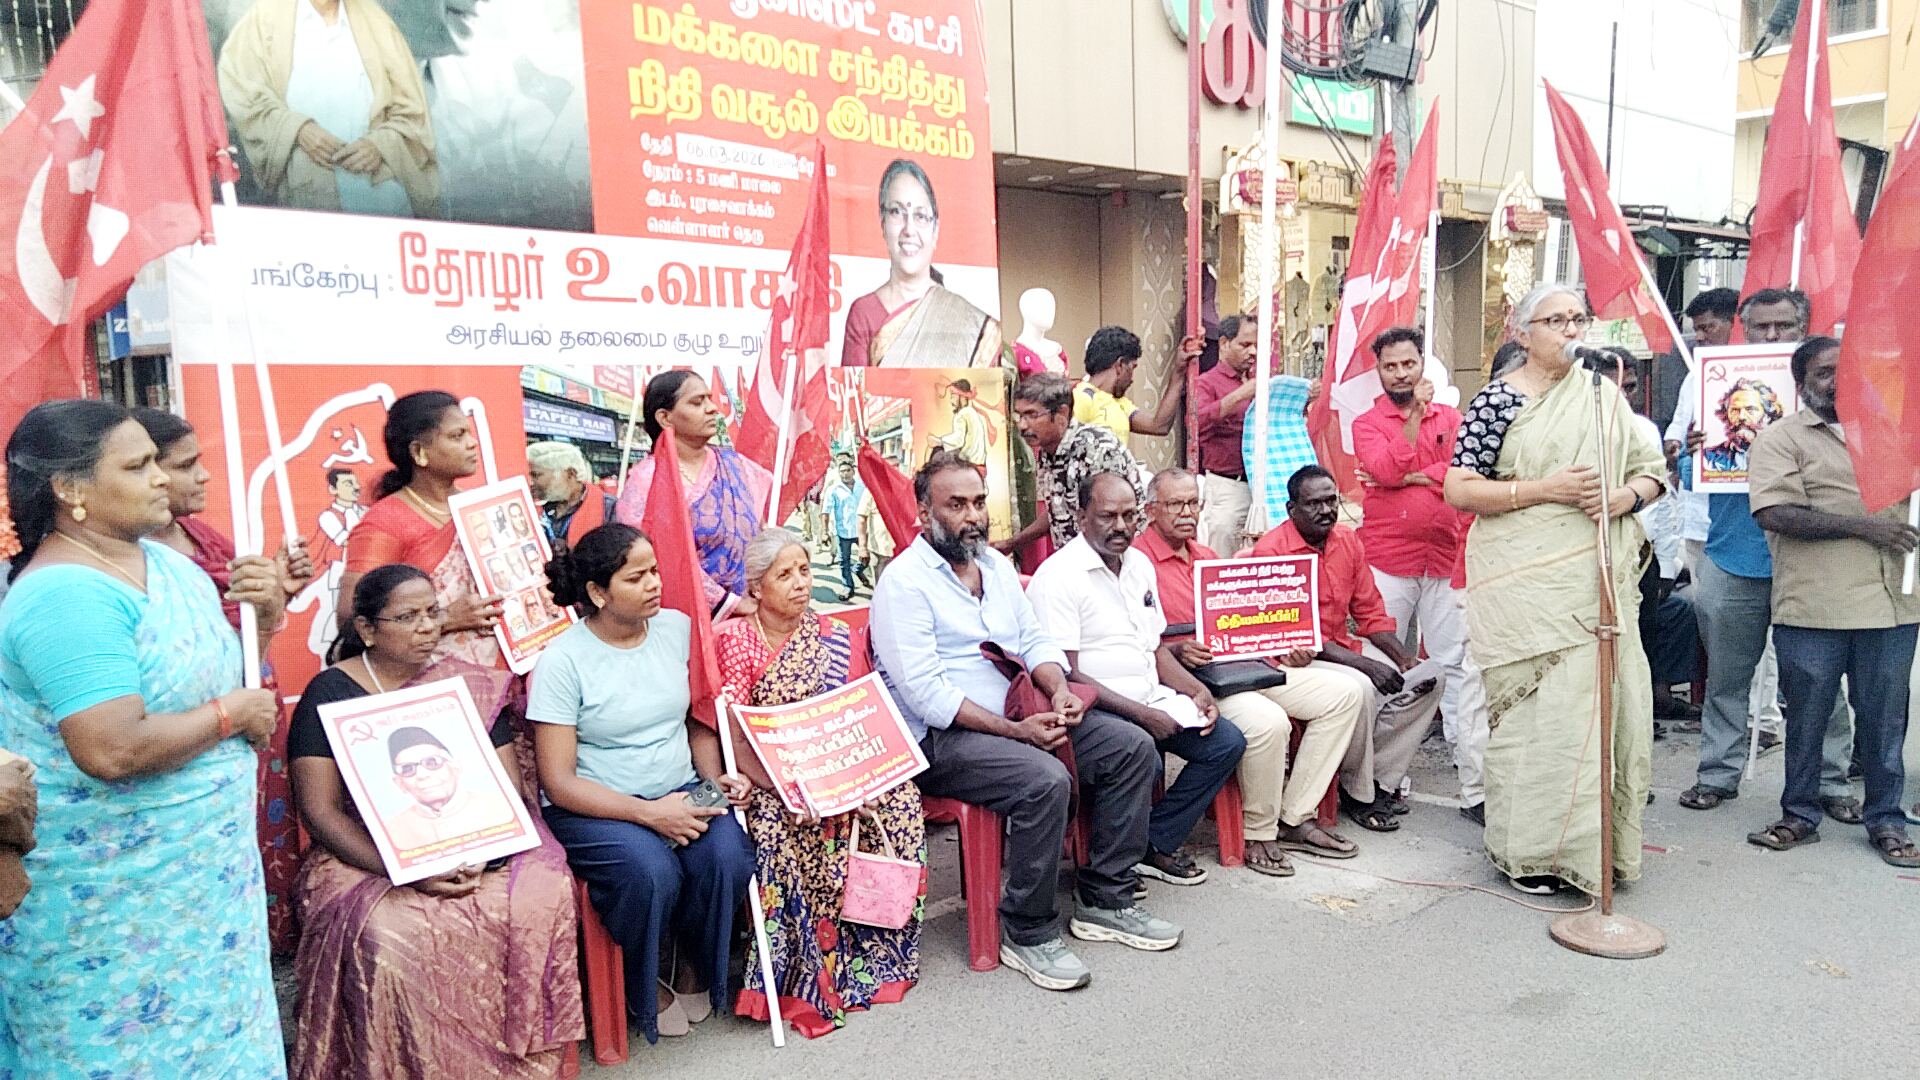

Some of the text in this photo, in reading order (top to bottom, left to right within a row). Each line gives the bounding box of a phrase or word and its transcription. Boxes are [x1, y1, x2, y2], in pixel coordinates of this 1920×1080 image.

[886, 11, 963, 57] கட்சி
[632, 2, 967, 117] மக்களை சந்தித்து
[628, 57, 975, 160] நிதி வசூல் இயக்கம்
[640, 132, 673, 156] தேதி
[642, 159, 684, 183] நேரம்
[696, 167, 706, 184] 5
[708, 171, 739, 190] மணி
[741, 177, 782, 195] மாலை
[690, 194, 776, 219] புரசைவாக்கம்
[647, 216, 765, 246] வெள்ளாளர் தெரு
[399, 229, 544, 312] தோழர்
[446, 321, 552, 348] அரசியல்
[559, 327, 667, 349] தலைமை
[672, 333, 713, 356] குழு
[529, 408, 580, 426] PAPER
[582, 418, 612, 432] MART
[1216, 607, 1300, 630] நிதியளிப்பீர்!!
[775, 722, 869, 765] ஆதரிப்பீர்!!
